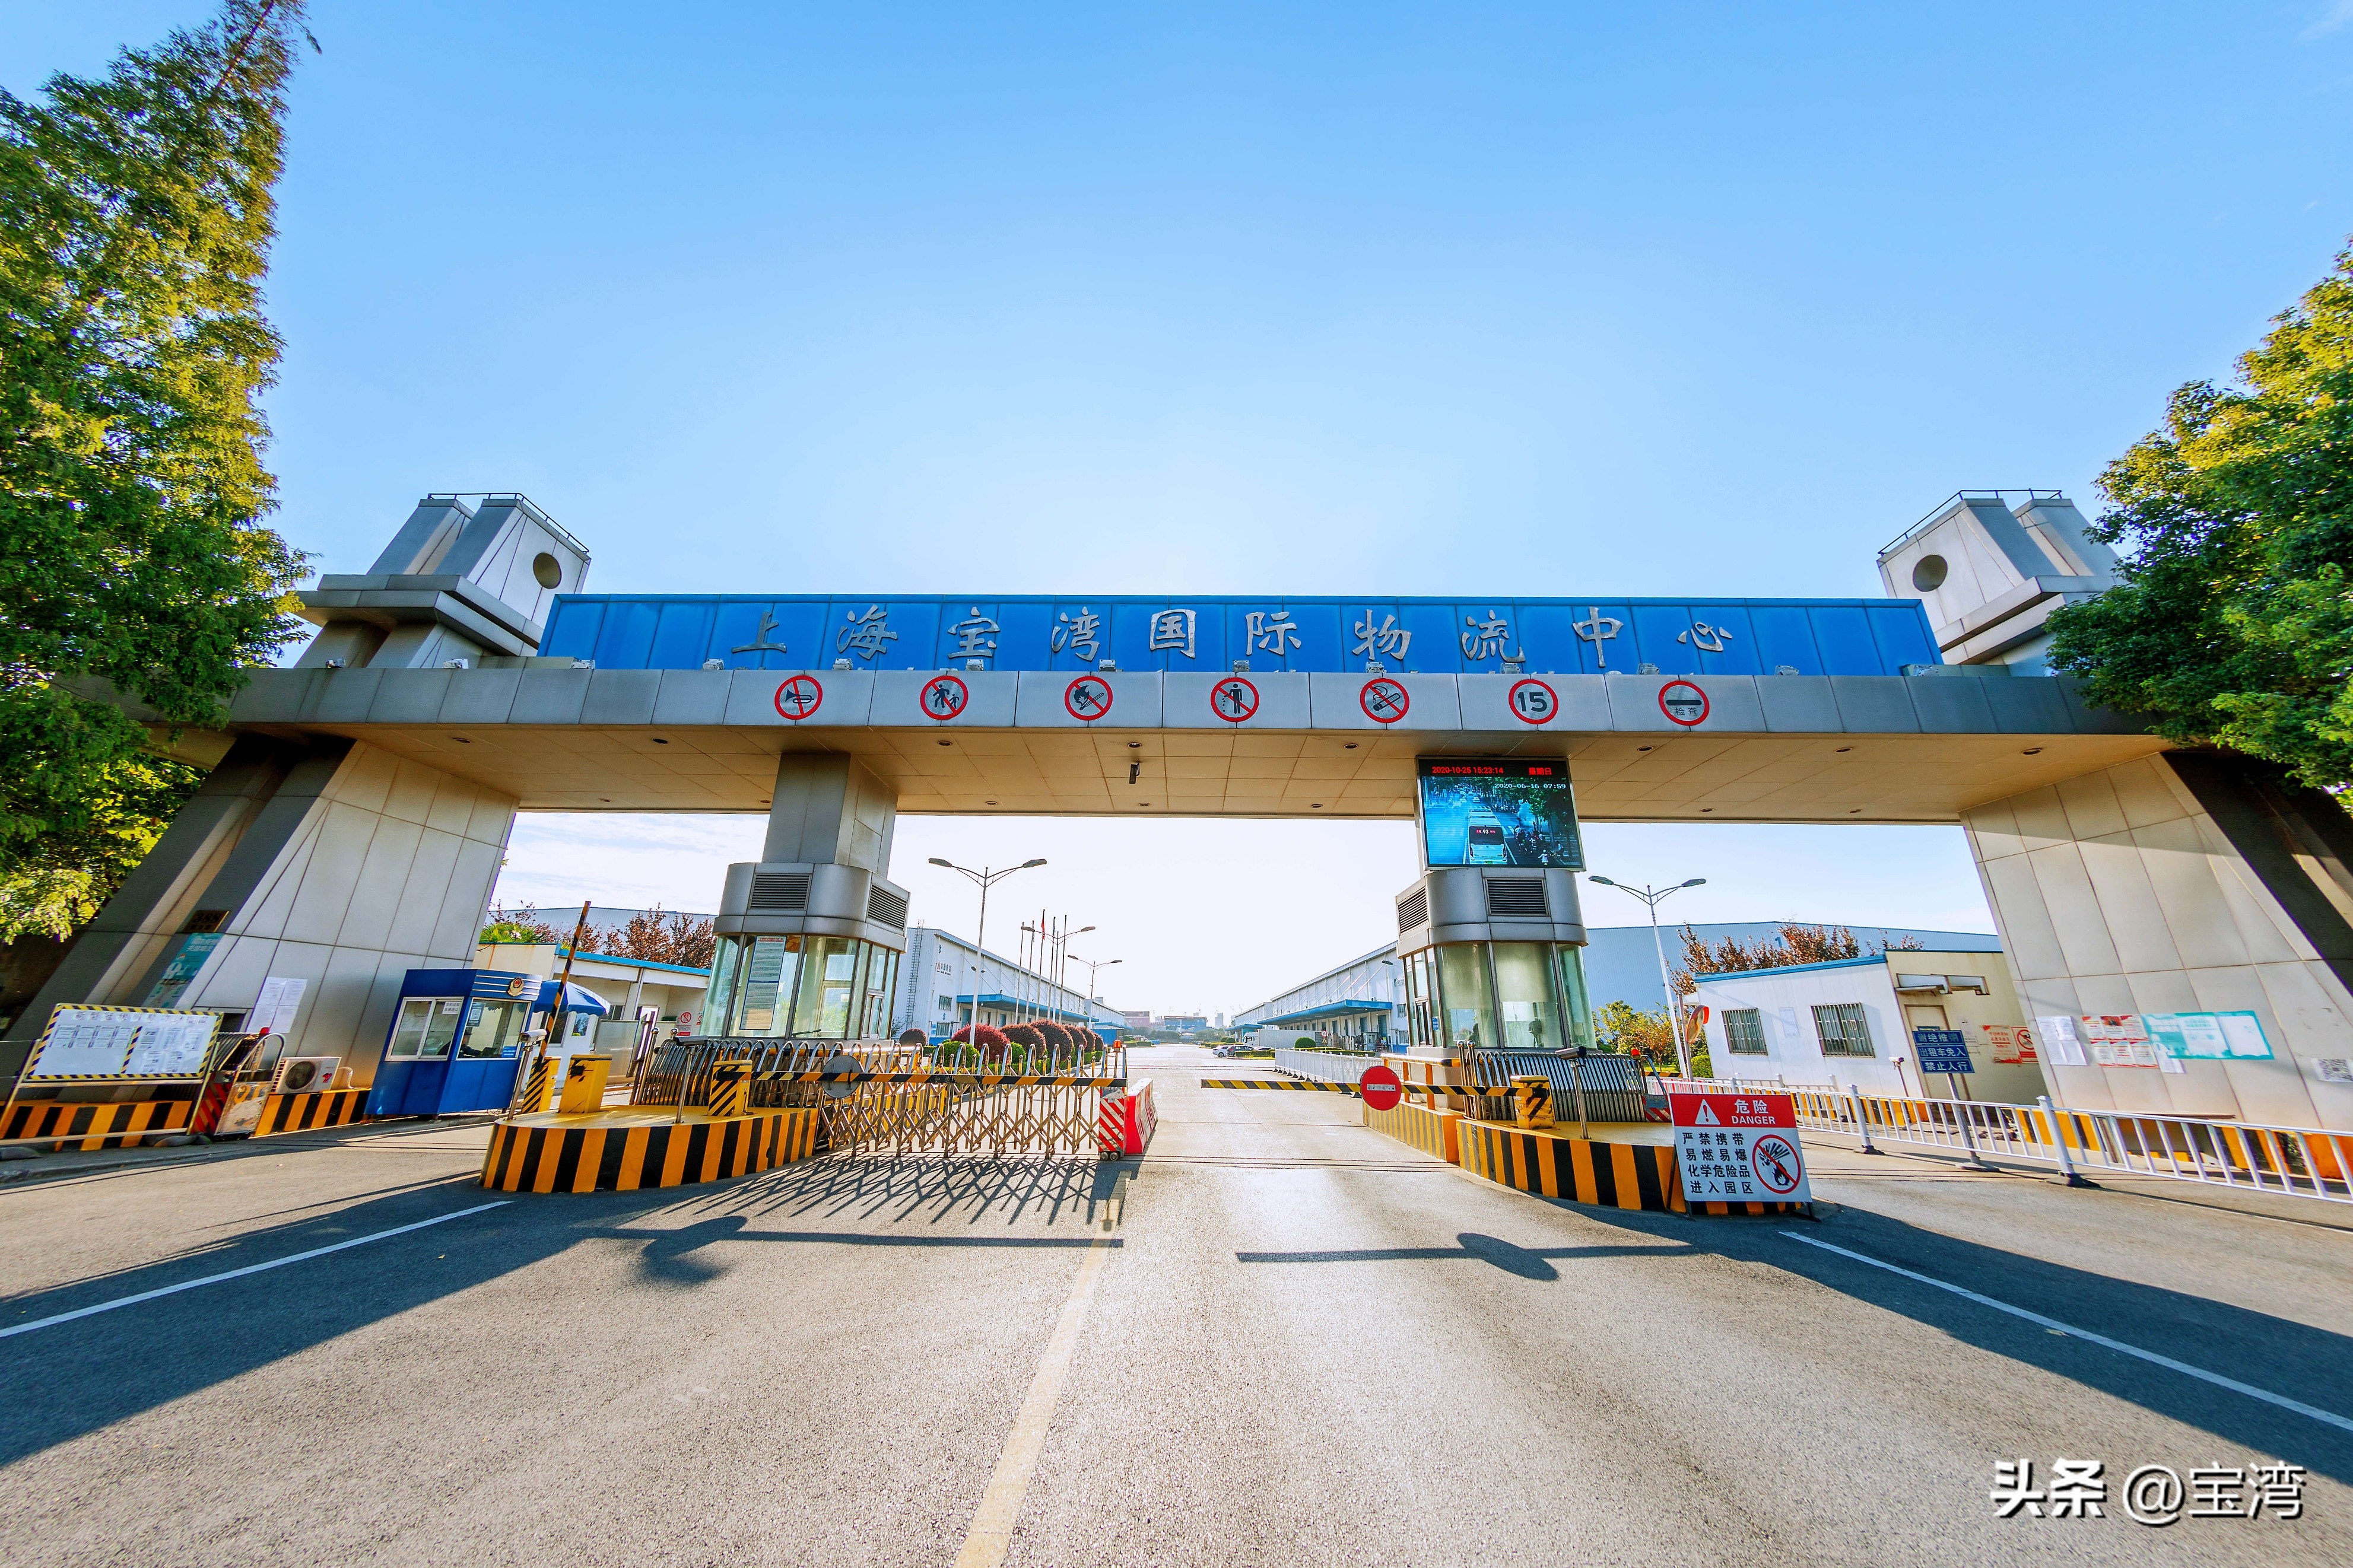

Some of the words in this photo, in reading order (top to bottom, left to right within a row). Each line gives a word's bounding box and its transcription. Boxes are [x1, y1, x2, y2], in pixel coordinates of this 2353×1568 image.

[731, 604, 1733, 668] 上海宝湾国际物流中心
[1517, 692, 1545, 713] 15
[1674, 707, 1698, 716] 检查
[1528, 767, 1552, 775] 星期日
[1917, 1033, 1959, 1042] 谢绝推销
[1919, 1047, 1965, 1057] 出租车免入
[1924, 1061, 1968, 1071] 禁止人行
[1734, 1099, 1768, 1114] 危险
[1731, 1115, 1776, 1125] DANGER
[1682, 1132, 1744, 1146] 严禁携带
[1685, 1148, 1748, 1162] 易燃易爆
[1688, 1164, 1751, 1178] 化学危险品
[1690, 1181, 1754, 1194] 进入园区
